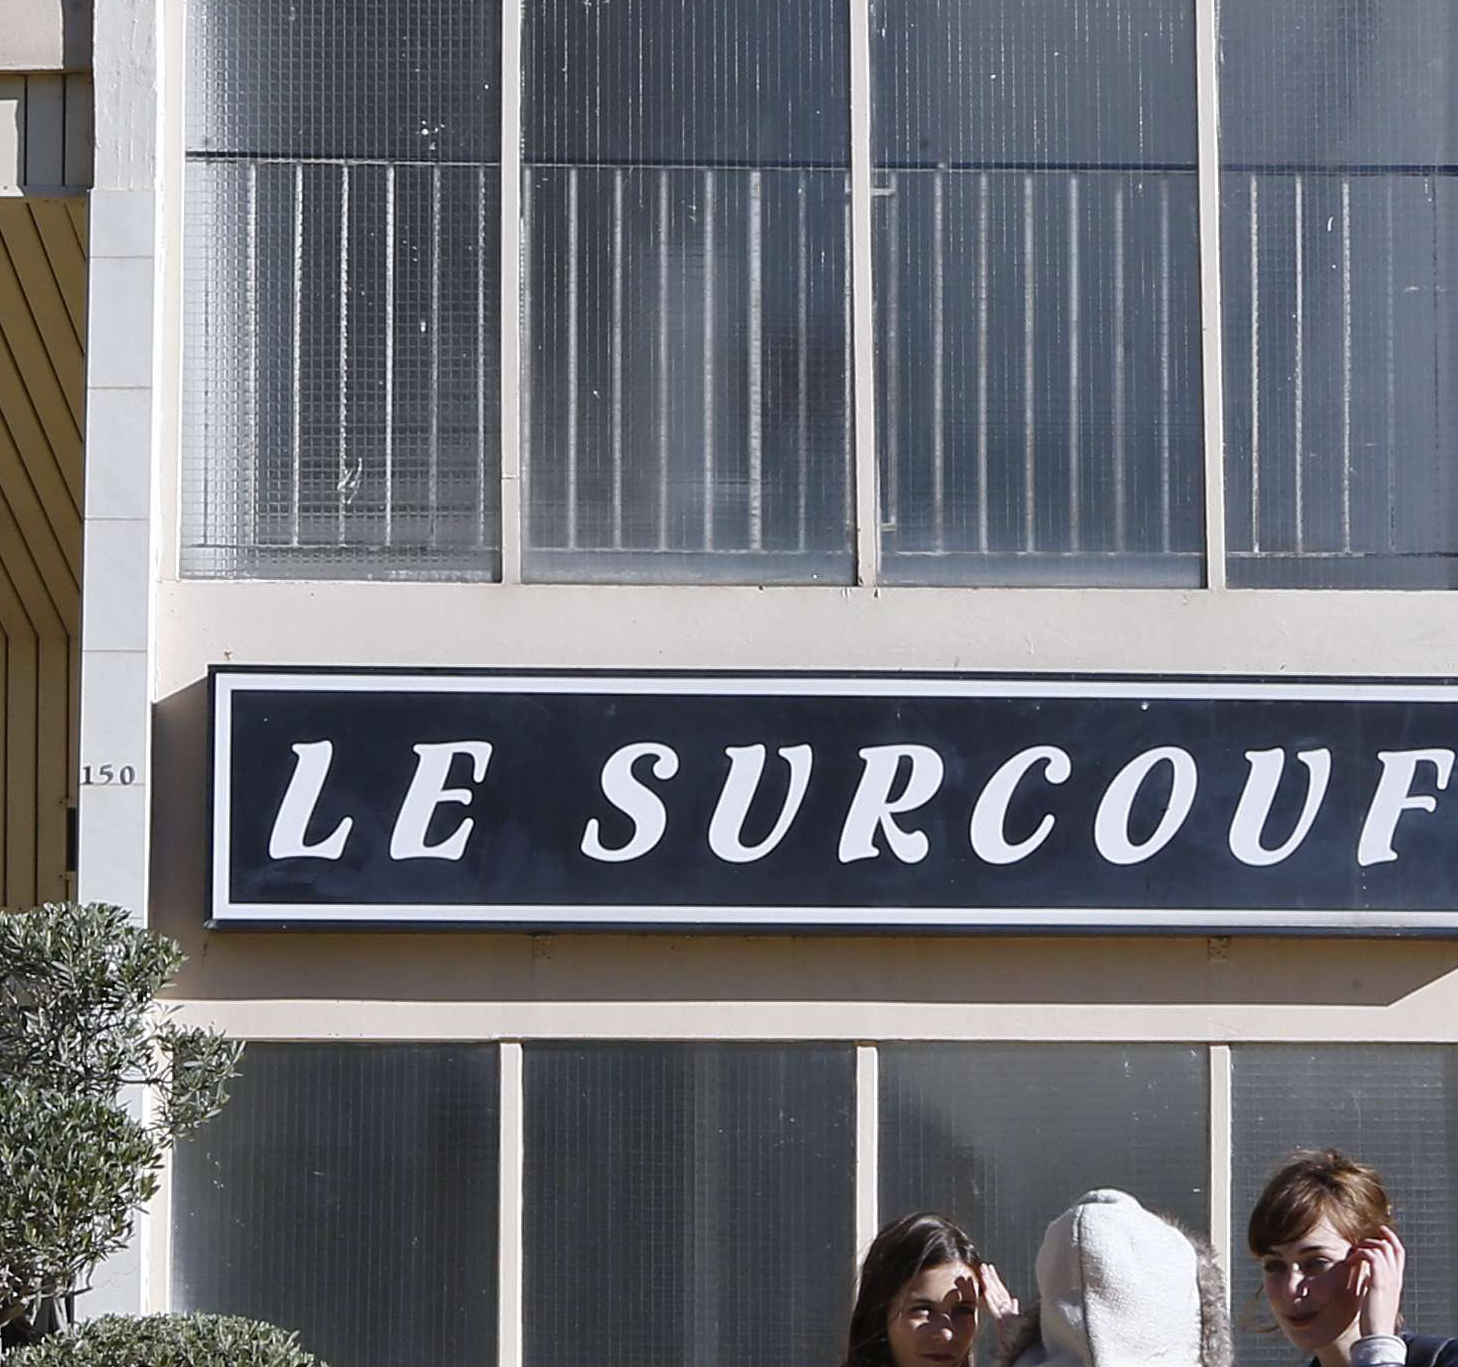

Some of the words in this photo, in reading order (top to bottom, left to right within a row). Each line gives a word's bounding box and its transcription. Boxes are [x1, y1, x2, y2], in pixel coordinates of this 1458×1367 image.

[83, 763, 135, 786] 150
[270, 741, 492, 860] LE
[581, 743, 1455, 866] SURCOUF
